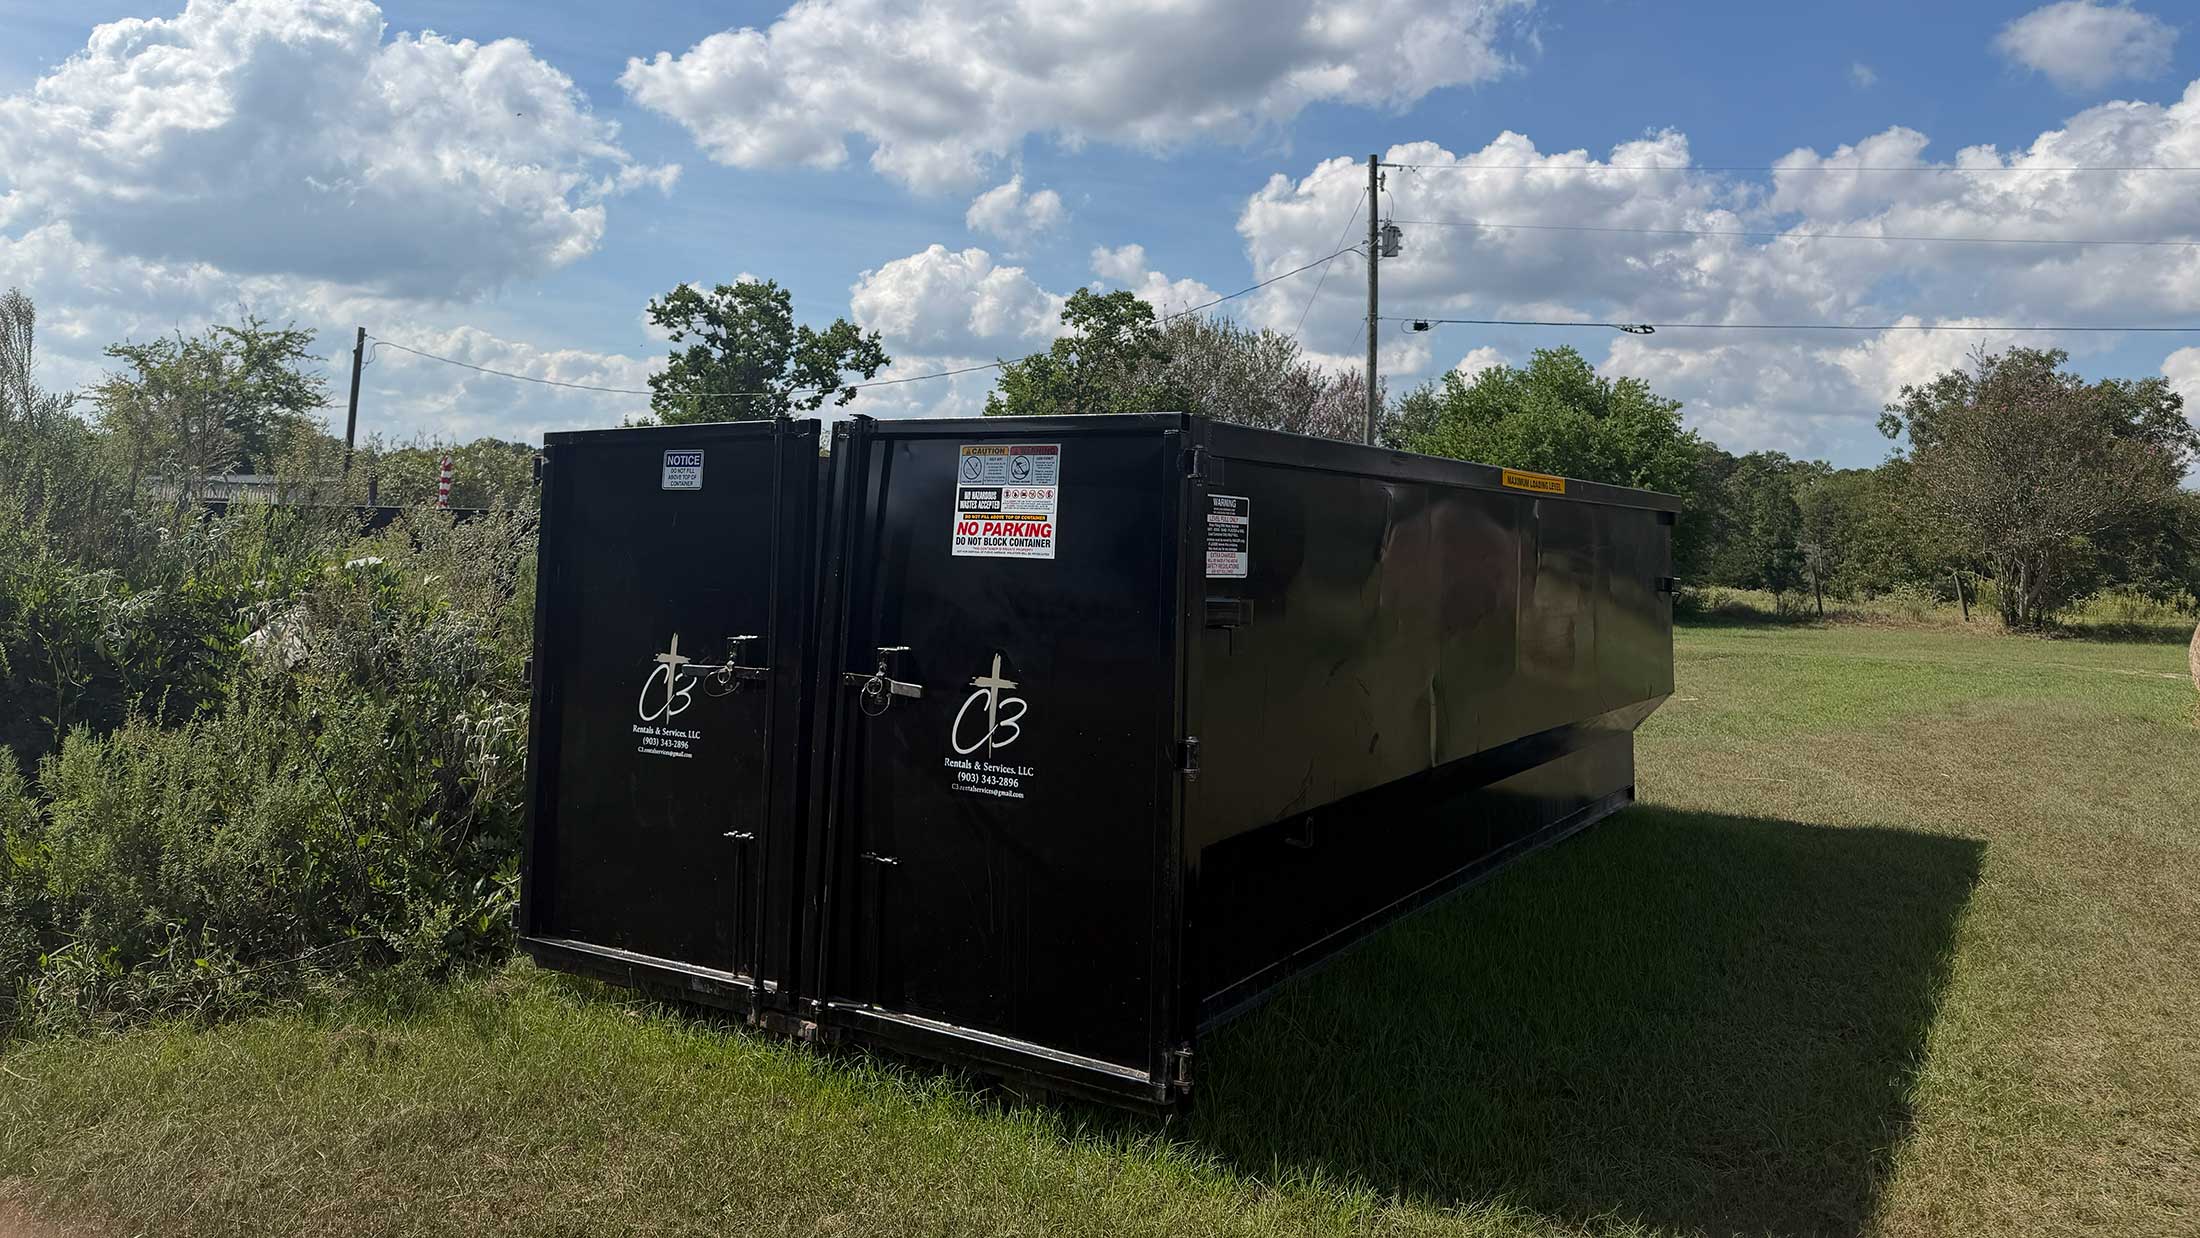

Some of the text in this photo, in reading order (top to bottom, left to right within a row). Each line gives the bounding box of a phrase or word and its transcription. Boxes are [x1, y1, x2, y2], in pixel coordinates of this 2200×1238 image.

[971, 447, 1005, 455] CAUTION
[667, 455, 700, 466] NOTICE
[964, 491, 997, 500] NO HAZARDOUS
[960, 500, 977, 509] WASTES
[978, 500, 1000, 510] ACCEPTED
[1212, 498, 1237, 508] WARNING
[957, 521, 1052, 538] NO PARKING
[955, 537, 1051, 548] DO NOT BLOCK CONTAINER
[952, 688, 1027, 755] C3
[632, 724, 654, 735] Rentals
[655, 727, 661, 736] &
[688, 730, 701, 740] LLC
[642, 737, 689, 750] (903) 343-2896
[944, 757, 972, 770] Rentals
[974, 761, 981, 771] &
[1018, 765, 1034, 777] LLC
[957, 771, 1019, 788] (903) 343-2896
